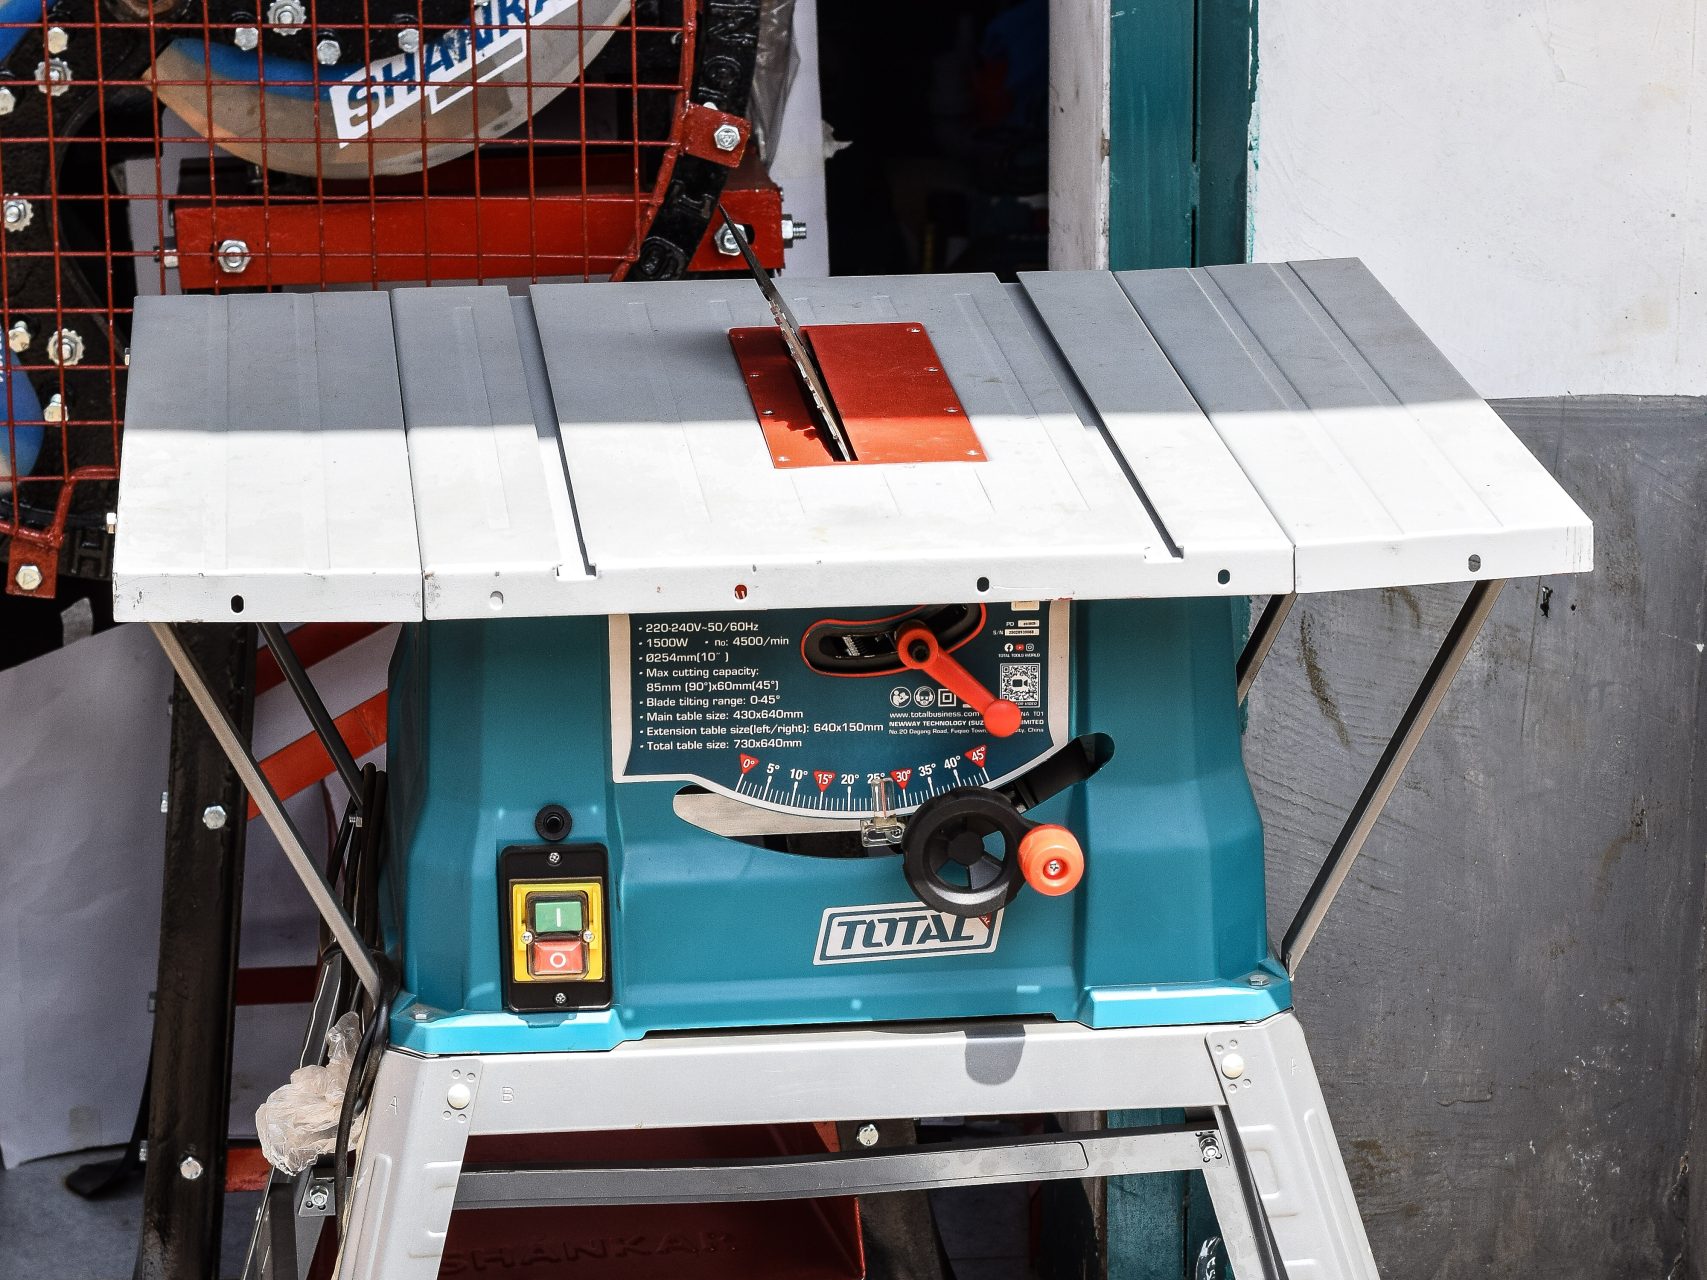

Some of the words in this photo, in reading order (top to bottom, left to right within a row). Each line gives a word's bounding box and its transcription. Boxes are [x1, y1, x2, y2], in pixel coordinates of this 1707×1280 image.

[646, 622, 759, 633] 220-240V~50/60Hz
[646, 638, 688, 648] 1500W
[733, 636, 789, 646] 4500/min
[647, 668, 669, 677] Max
[673, 668, 709, 678] cutting
[713, 667, 759, 678] capacity:
[647, 683, 681, 692] 85mm
[647, 698, 675, 707] Blade
[679, 697, 709, 708] tilting
[713, 697, 745, 707] range:
[750, 695, 780, 704] 0-45°
[647, 713, 673, 721] Main
[677, 712, 702, 721] table
[706, 712, 729, 720] size:
[733, 710, 803, 719] 430x640mm
[647, 727, 696, 736] Extension
[701, 726, 727, 735] table
[730, 724, 809, 735] size(left/right):
[814, 722, 884, 733] 640x150mm
[647, 741, 673, 750] Total
[677, 741, 702, 750] table
[706, 741, 729, 749] size:
[734, 739, 802, 748] 730x640mm
[742, 758, 755, 768] 0°
[766, 763, 780, 773] 5°
[790, 769, 808, 780] 10°
[818, 774, 833, 784] 15°
[841, 774, 859, 784] 20°
[867, 773, 885, 784] 25°
[896, 770, 911, 782] 30°
[918, 764, 936, 777] 35°
[944, 756, 961, 769] 40°
[971, 748, 985, 761] 45°
[837, 914, 974, 950] TOTAL
[440, 1230, 736, 1277] SHANKAR
